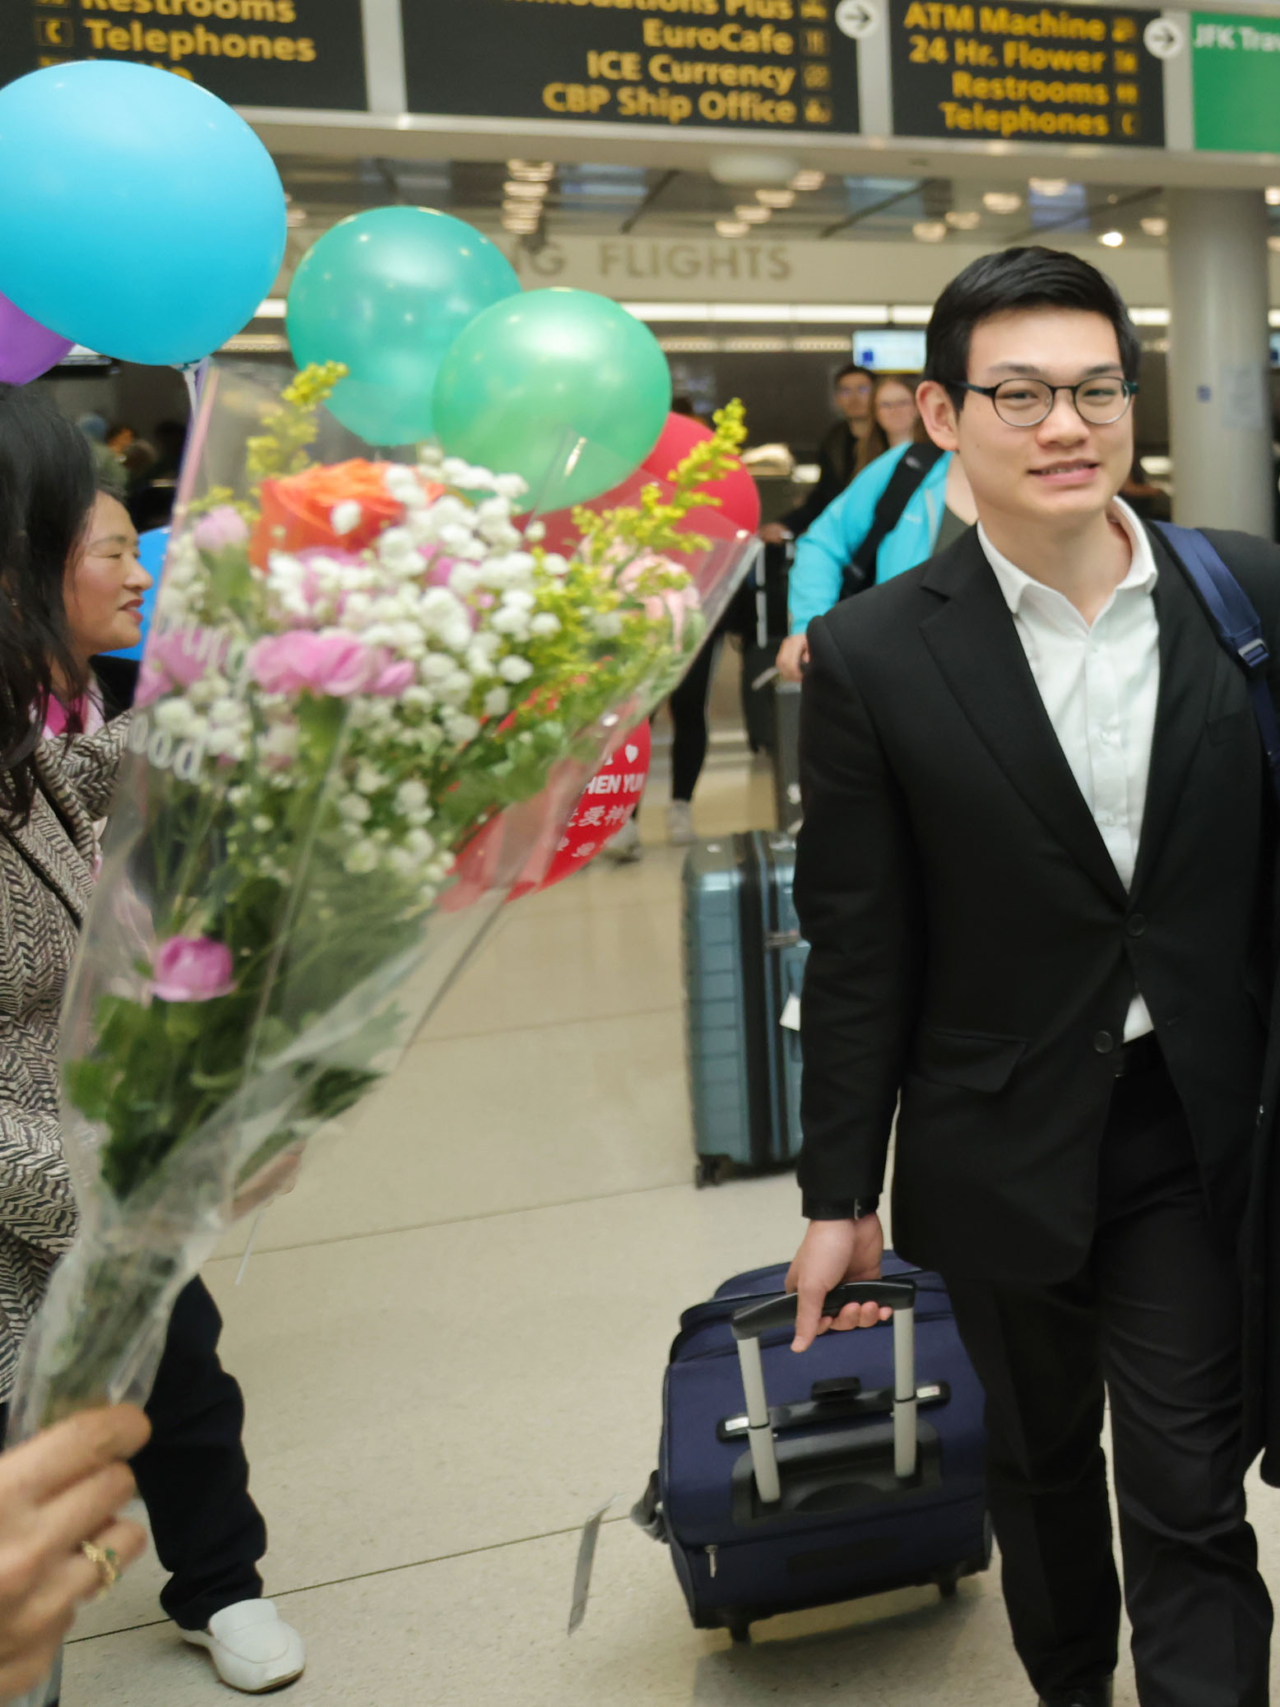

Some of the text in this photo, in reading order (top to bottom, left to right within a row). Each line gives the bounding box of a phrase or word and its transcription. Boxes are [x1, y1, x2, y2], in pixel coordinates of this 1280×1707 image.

[84, 19, 316, 62] Telephones
[642, 18, 794, 54] EuroCafe
[904, 2, 1106, 41] ATM Machine
[1195, 23, 1235, 49] JFK
[587, 50, 796, 96] ICE Currency
[908, 35, 1106, 73] 24 Hr. Flower
[542, 82, 797, 125] CBP Ship Office
[952, 70, 1109, 106] Restrooms
[938, 101, 1109, 137] Telephones
[599, 242, 793, 281] FLIGHTS
[582, 774, 622, 795] HEN
